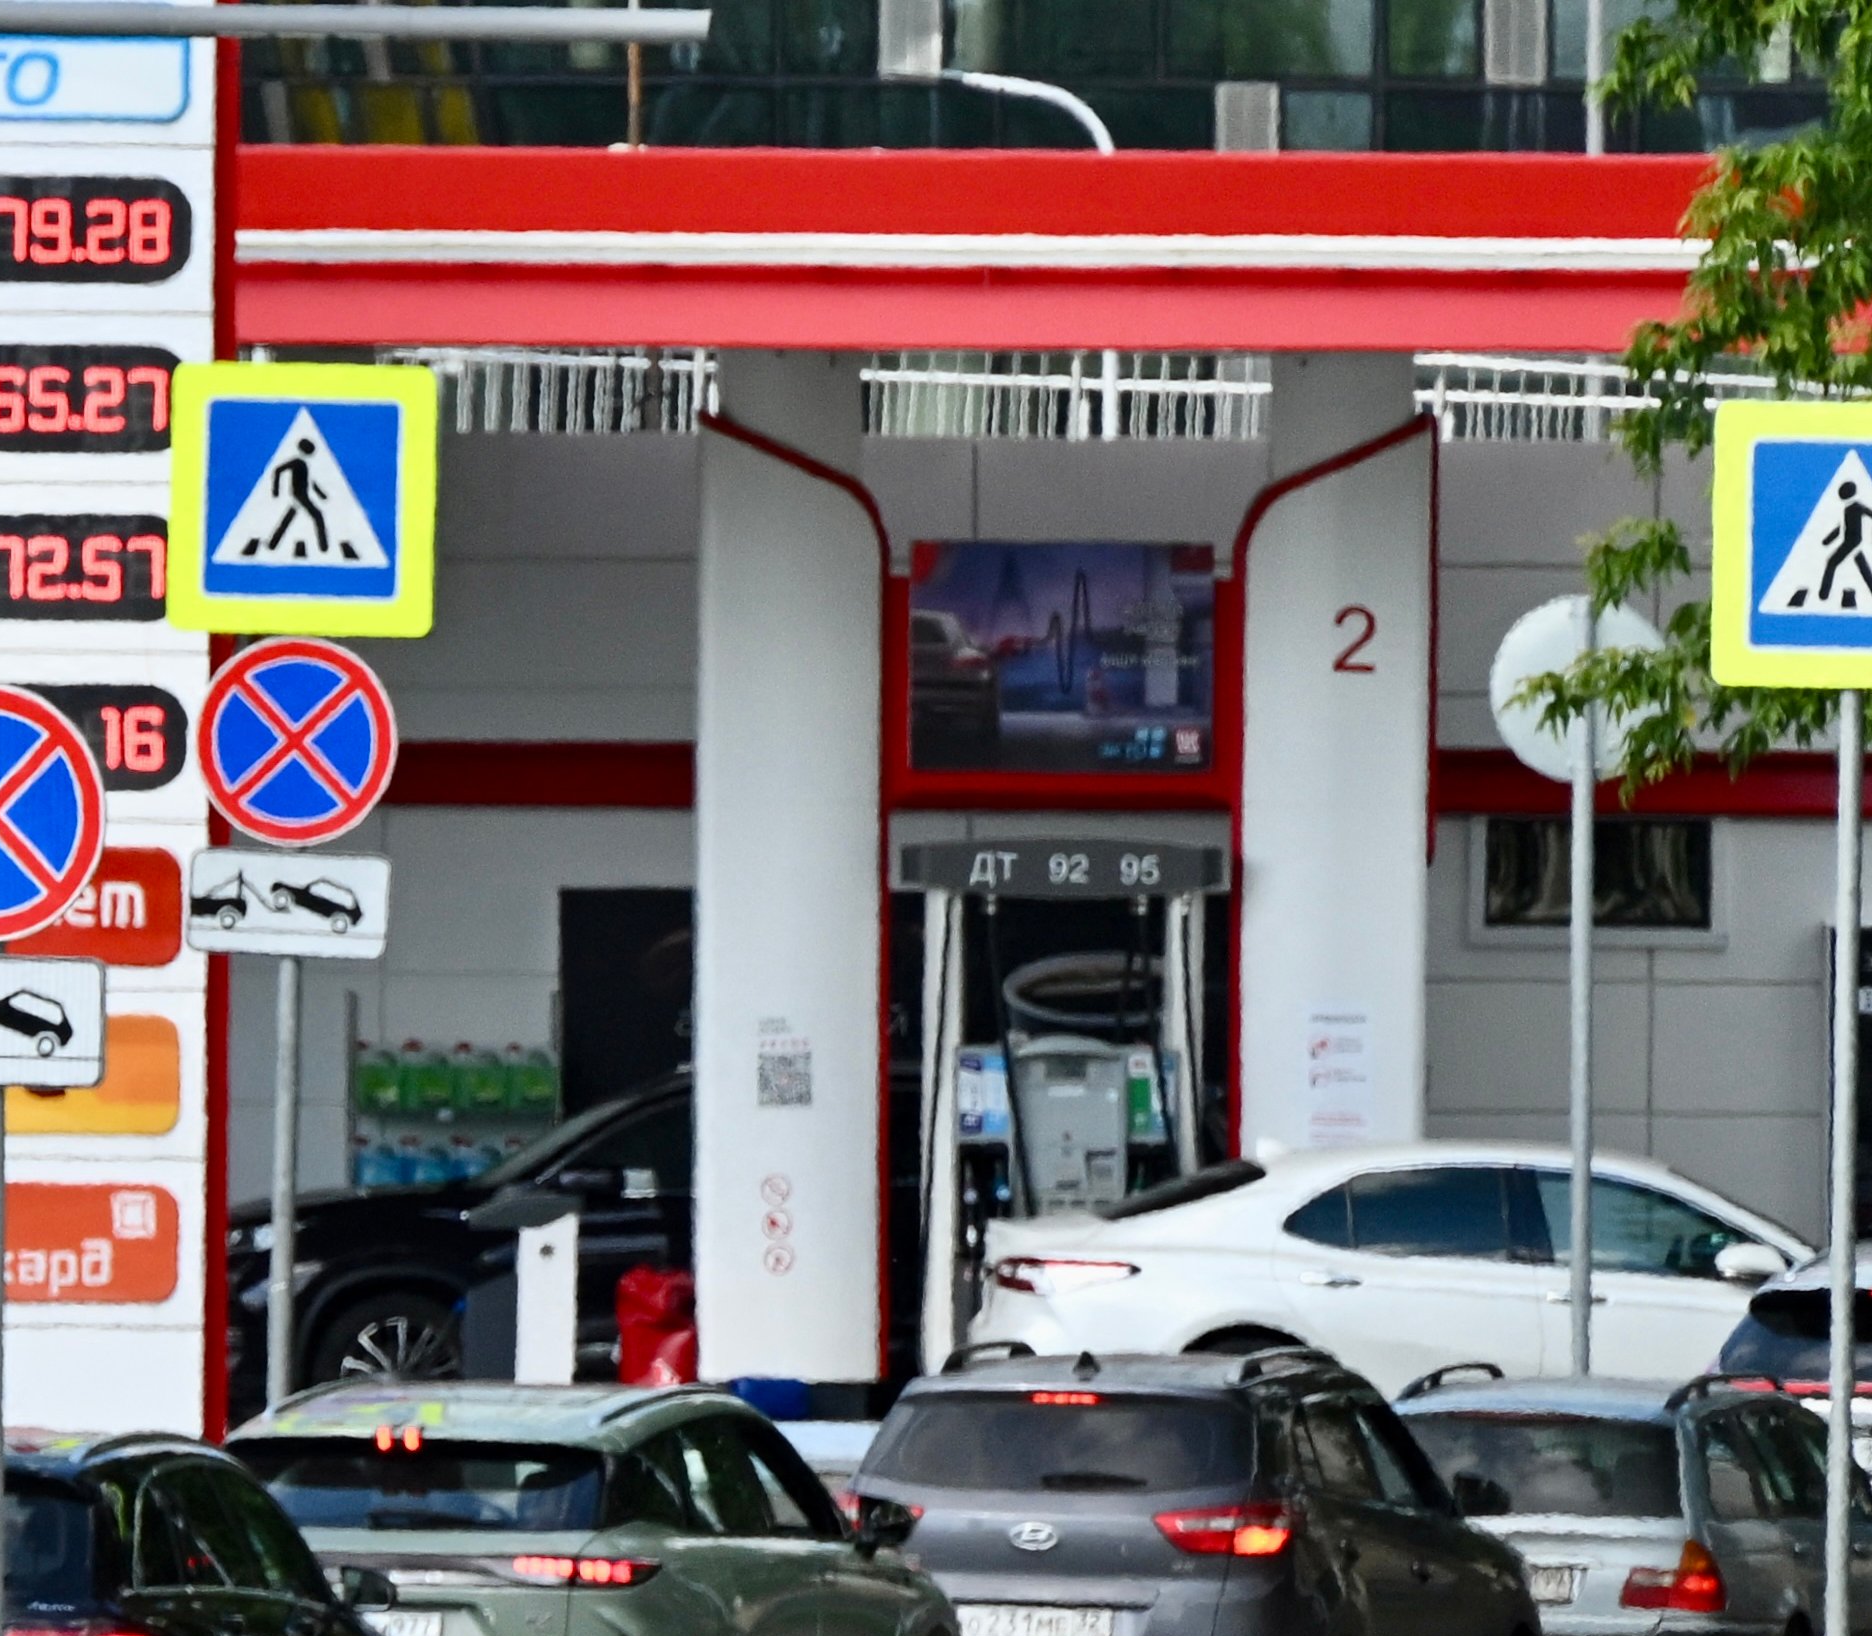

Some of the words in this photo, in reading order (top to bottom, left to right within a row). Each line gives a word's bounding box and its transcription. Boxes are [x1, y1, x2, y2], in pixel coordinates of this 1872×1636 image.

[1332, 605, 1377, 673] 2
[969, 853, 1018, 888] ДТ
[1048, 854, 1089, 884] 92
[1120, 854, 1161, 885] 95
